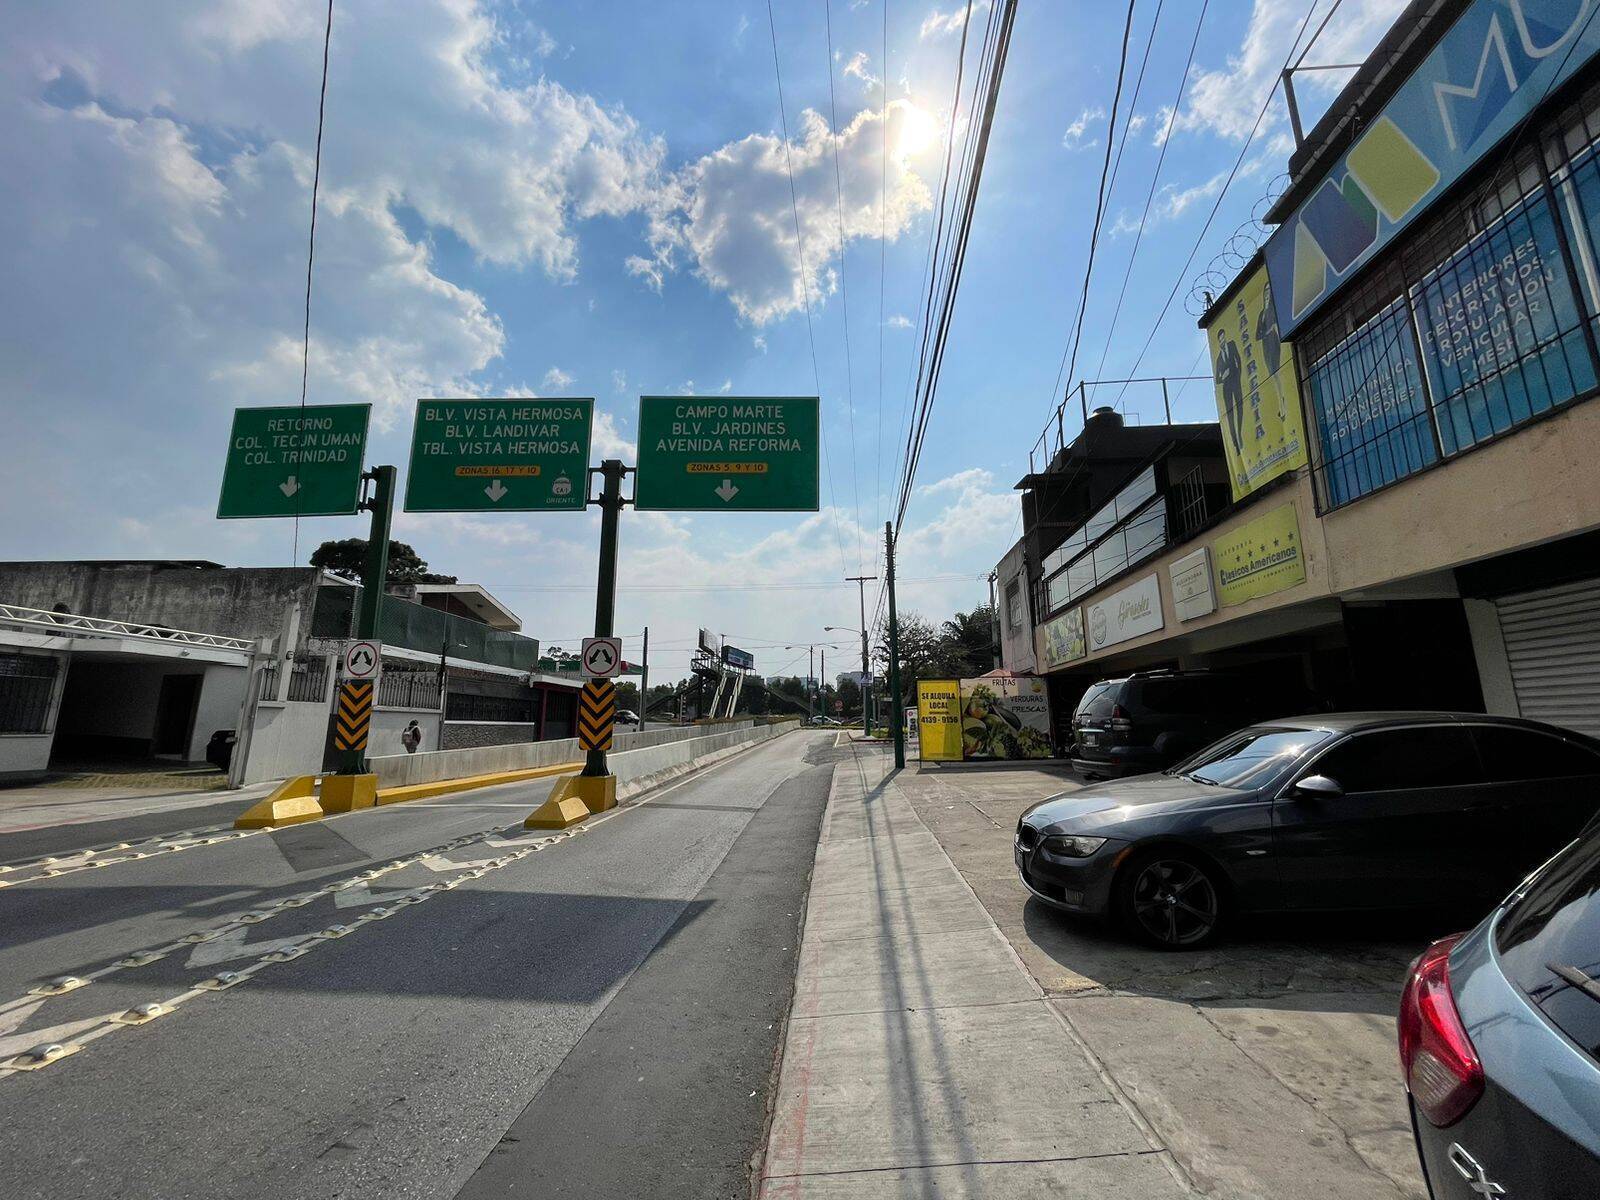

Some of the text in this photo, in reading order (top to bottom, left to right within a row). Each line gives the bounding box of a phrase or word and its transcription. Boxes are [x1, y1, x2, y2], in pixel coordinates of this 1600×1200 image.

[1436, 237, 1538, 317] INTERIORES
[1425, 255, 1545, 343] DECORATVOS
[1440, 267, 1555, 353] ROTULACIÓN
[1441, 300, 1541, 368] VEHICULAR
[1472, 333, 1519, 370] MESH
[1343, 385, 1395, 423] ANNERS
[425, 407, 583, 421] BLV. VISTA HERMOSA
[675, 405, 784, 419] CAMPO MARTE
[1331, 387, 1416, 442] ROTULACIONES
[267, 418, 333, 432] RETORNO
[445, 424, 560, 438] BLV. LANDIVAR
[672, 422, 786, 435] BLV. JARDINES
[235, 436, 267, 449] COL.
[321, 433, 361, 446] UMAN
[422, 441, 580, 455] TBL. VISTA HERMOSA
[655, 438, 801, 452] AVENIDA REFORMA
[244, 449, 347, 465] COL. TRINIDAD
[459, 467, 488, 475] ZONAS
[527, 466, 537, 474] 10
[690, 463, 721, 472] ZONAS
[753, 463, 764, 471] 10
[1249, 545, 1297, 572] Americanos
[992, 678, 1016, 687] FRUTAS
[921, 692, 956, 700] SE ALQUILA
[1010, 695, 1044, 703] VERDURAS
[929, 702, 949, 710] LOCAL
[1011, 706, 1047, 714] FRESCAS
